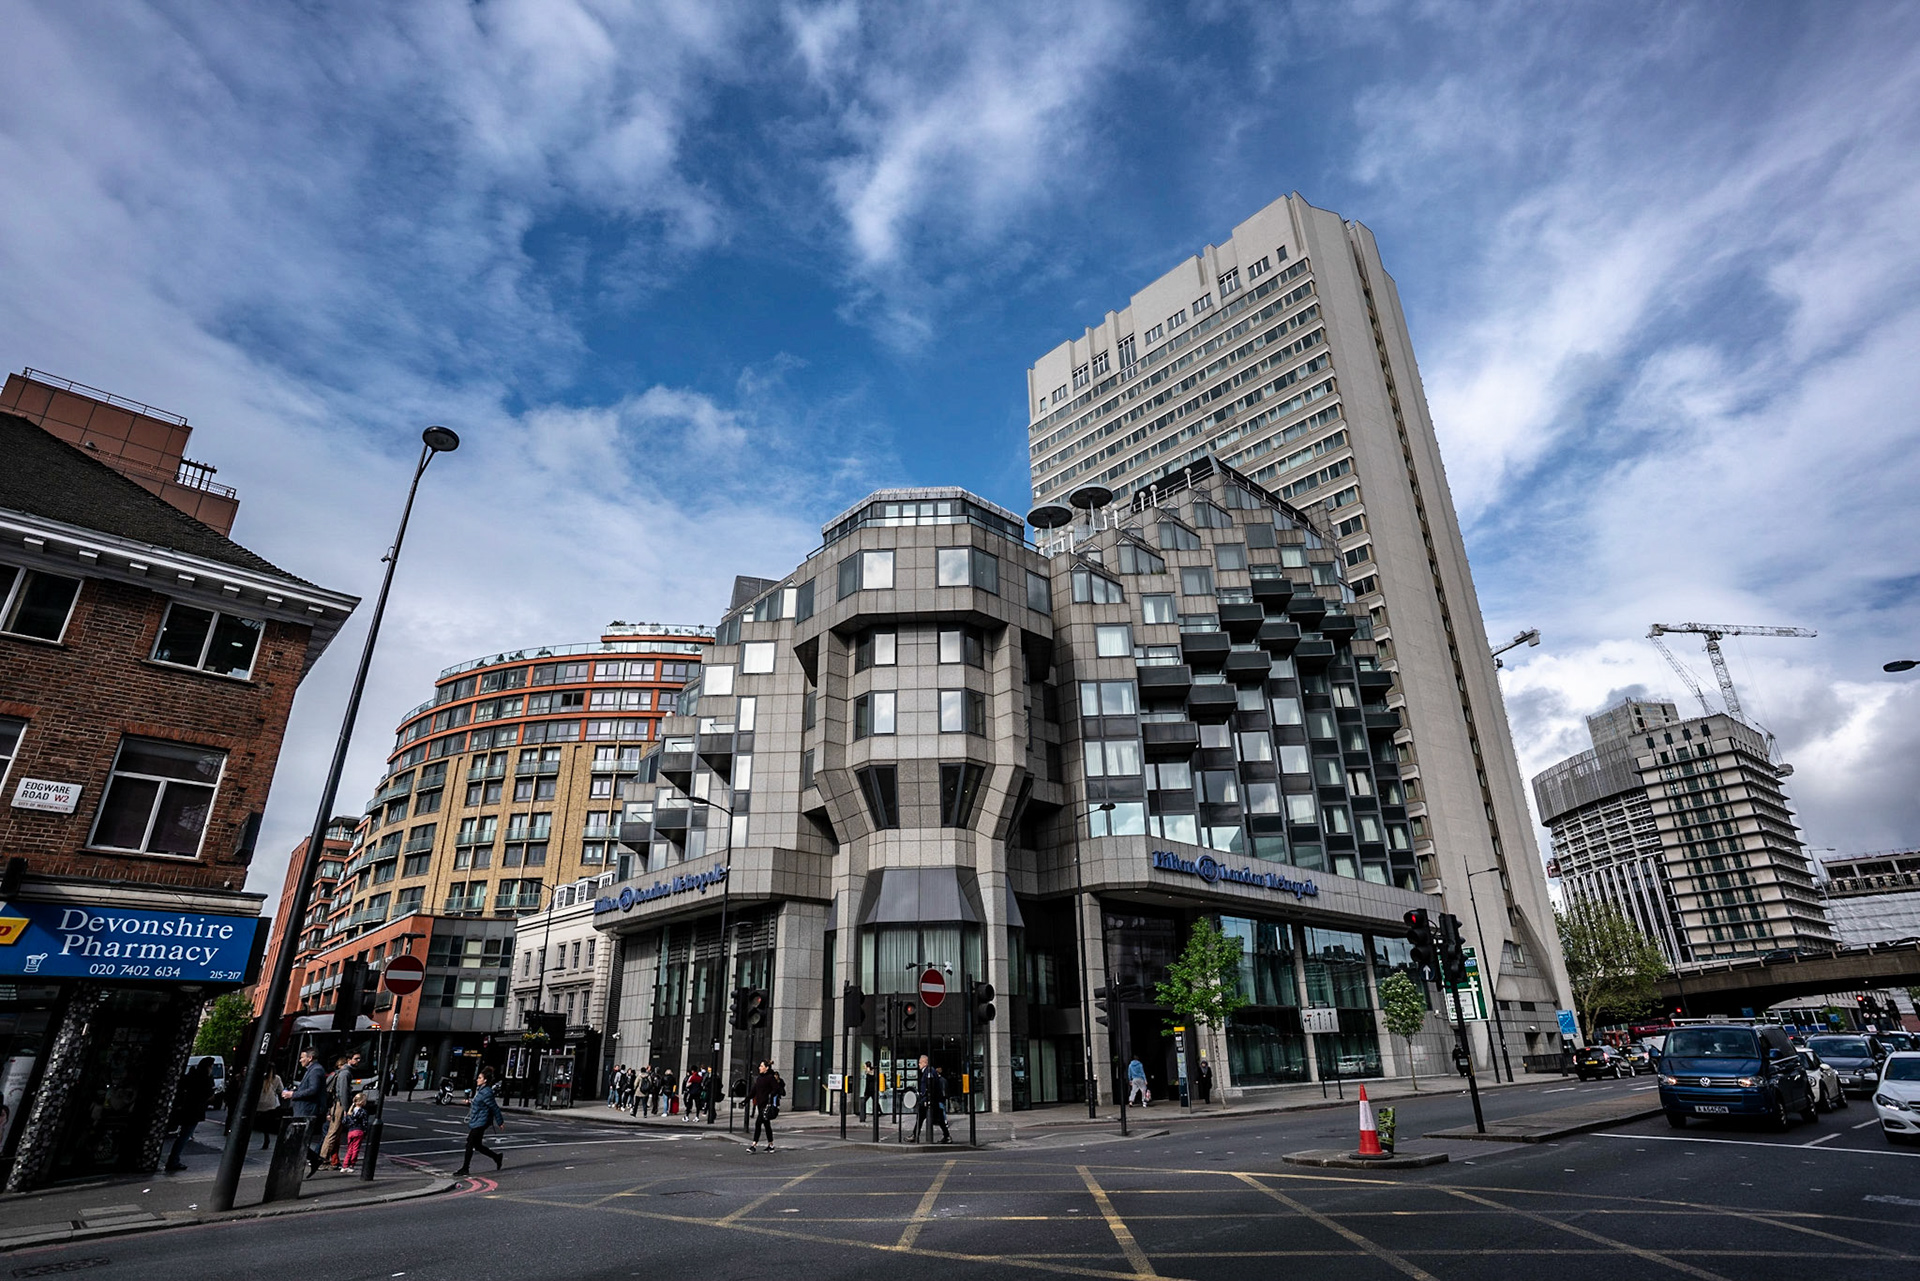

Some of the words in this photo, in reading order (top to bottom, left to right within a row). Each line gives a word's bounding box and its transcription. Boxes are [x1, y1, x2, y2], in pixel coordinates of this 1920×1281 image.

[21, 790, 50, 801] ROAD
[54, 793, 70, 803] W2
[25, 781, 71, 795] EDGWARE
[672, 862, 727, 893] Metropole
[1152, 850, 1196, 873] Hilton
[1220, 864, 1265, 886] London
[1266, 872, 1319, 899] Metropole
[57, 908, 234, 939] Devonshire
[58, 933, 219, 966] Pharmacy
[89, 963, 116, 975] 020
[120, 964, 150, 977] 7402
[154, 966, 181, 978] 6134
[210, 970, 242, 980] 215-217
[261, 1033, 270, 1053] 24
